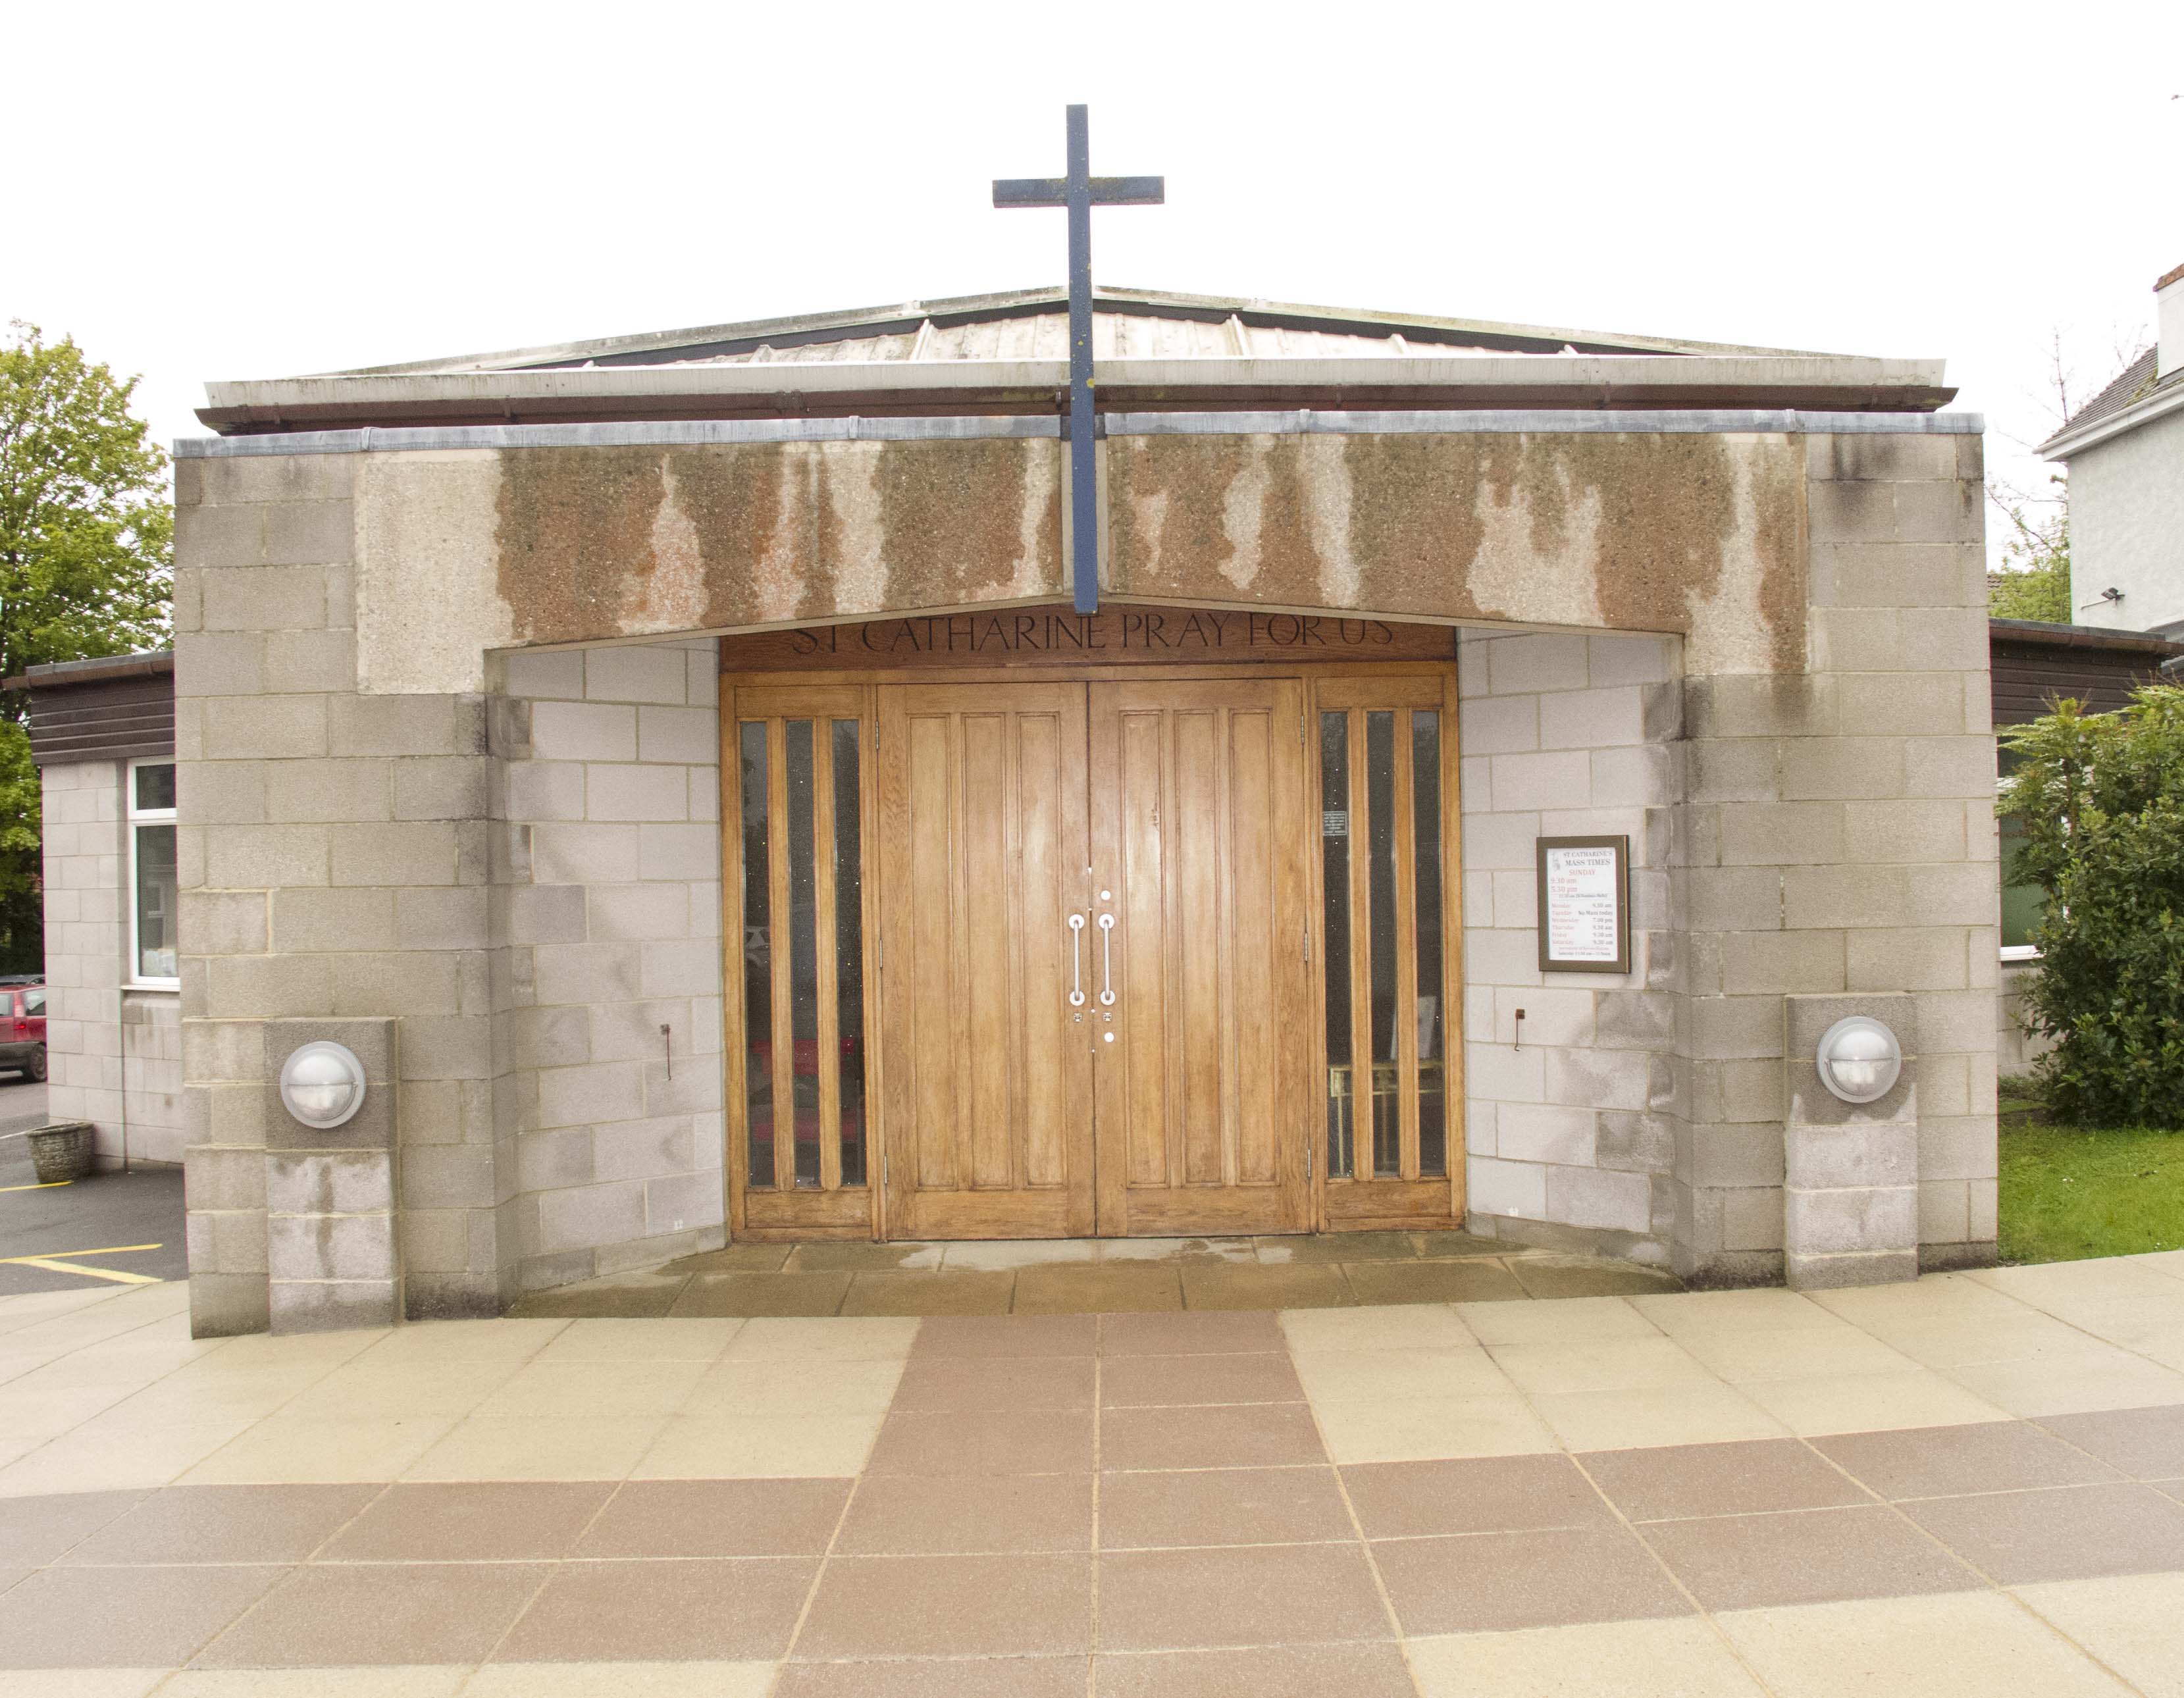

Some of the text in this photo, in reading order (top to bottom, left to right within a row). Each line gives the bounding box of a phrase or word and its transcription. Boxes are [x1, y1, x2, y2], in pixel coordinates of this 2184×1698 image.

[862, 615, 1106, 652] CATHARINE
[1123, 613, 1230, 648] PRAY
[1249, 612, 1326, 646] FOR
[1338, 618, 1393, 645] US
